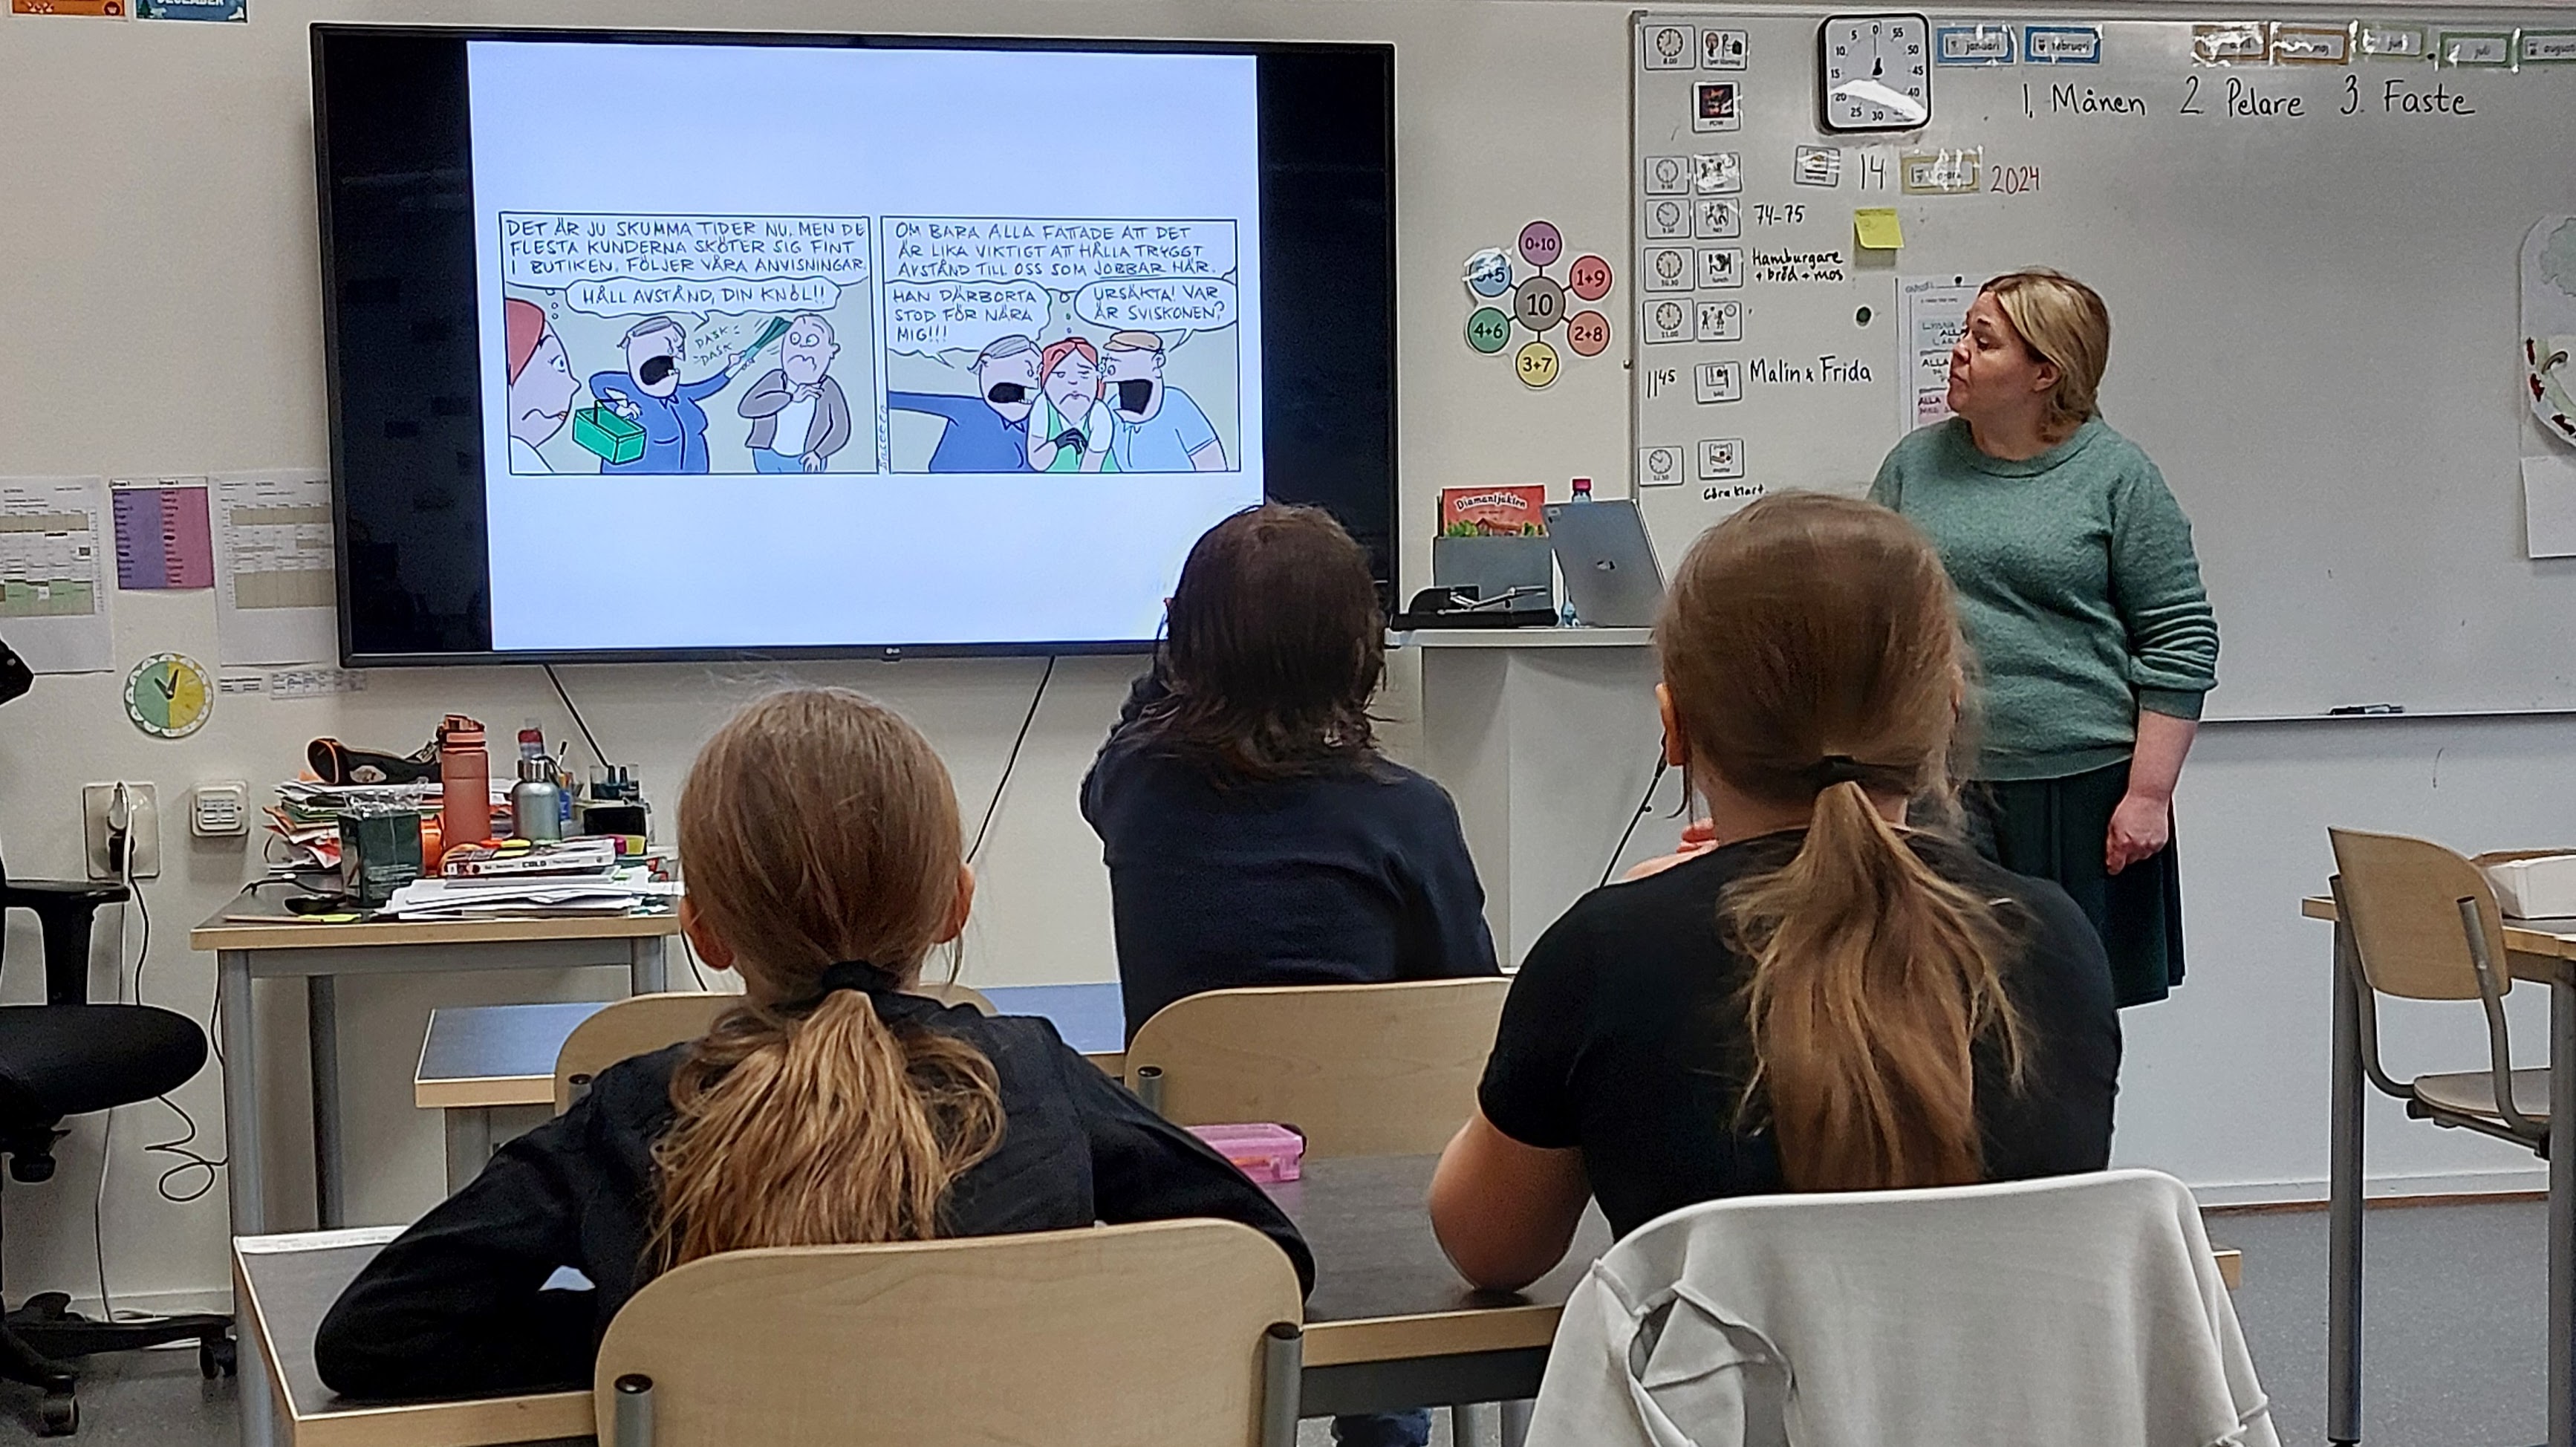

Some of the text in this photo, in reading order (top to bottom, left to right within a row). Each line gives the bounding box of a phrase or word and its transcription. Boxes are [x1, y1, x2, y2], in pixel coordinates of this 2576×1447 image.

[1851, 30, 1857, 41] 5
[1872, 25, 1879, 35] 0
[1893, 27, 1904, 38] 55
[1835, 45, 1846, 56] 10
[1907, 44, 1919, 55] 50
[1831, 68, 1840, 79] 15
[1912, 65, 1924, 76] 45
[1835, 92, 1847, 102] 20
[1907, 87, 1920, 97] 40
[2052, 82, 2146, 116] Månen
[2226, 77, 2306, 117] Pelare
[2384, 79, 2476, 115] Faste
[1850, 107, 1862, 117] 25
[1872, 111, 1884, 121] 30
[1861, 153, 1885, 189] 14
[1991, 165, 2040, 194] 2024
[1754, 204, 1806, 226] 74-75
[507, 217, 865, 238] DET ÄR JU SKUMMA TIDER NU. MEN DE
[896, 221, 1191, 240] OM BARA ALLA FATTADE ATT DET
[510, 235, 856, 256] FLESTA KUNDERNA SKÖTER SIG FINT
[898, 240, 1203, 259] ÄR LIKA VIKTIGT ATT HÅLLA TRYGGT
[1525, 237, 1555, 251] 0+10
[530, 259, 619, 274] BUTIKEN.
[626, 255, 695, 273] FÖLJER
[700, 254, 748, 273] VÅRA
[755, 258, 867, 273] ANVISNINGAR.
[898, 258, 1216, 277] AVSTÅND TILL OSS SOM JOBBAR HÄR.
[1752, 247, 1844, 270] Hamburgare
[1577, 269, 1605, 287] 1+9
[1768, 266, 1798, 282] bröd
[1815, 270, 1844, 282] mos
[582, 284, 627, 305] HÅLL
[634, 284, 715, 305] AVSTÅND,
[721, 287, 752, 302] DIN
[893, 285, 1037, 303] HAN DÄRBORTA
[1093, 284, 1219, 302] URSÄKTA! VAR
[895, 303, 1033, 323] STOD FÖR NÄRA
[1094, 300, 1225, 321] ÄR SVISKONEN?
[1526, 293, 1553, 316] 10
[897, 325, 947, 342] MIG!!!
[1474, 322, 1503, 339] 4+6
[1575, 325, 1603, 342] 2+8
[1523, 357, 1552, 373] 3+7
[1750, 358, 1801, 383] Malin
[1819, 355, 1872, 383] Frida
[1922, 359, 1949, 367] ALLA
[1918, 397, 1941, 406] ALLA
[1457, 492, 1526, 510] Diamantjakten
